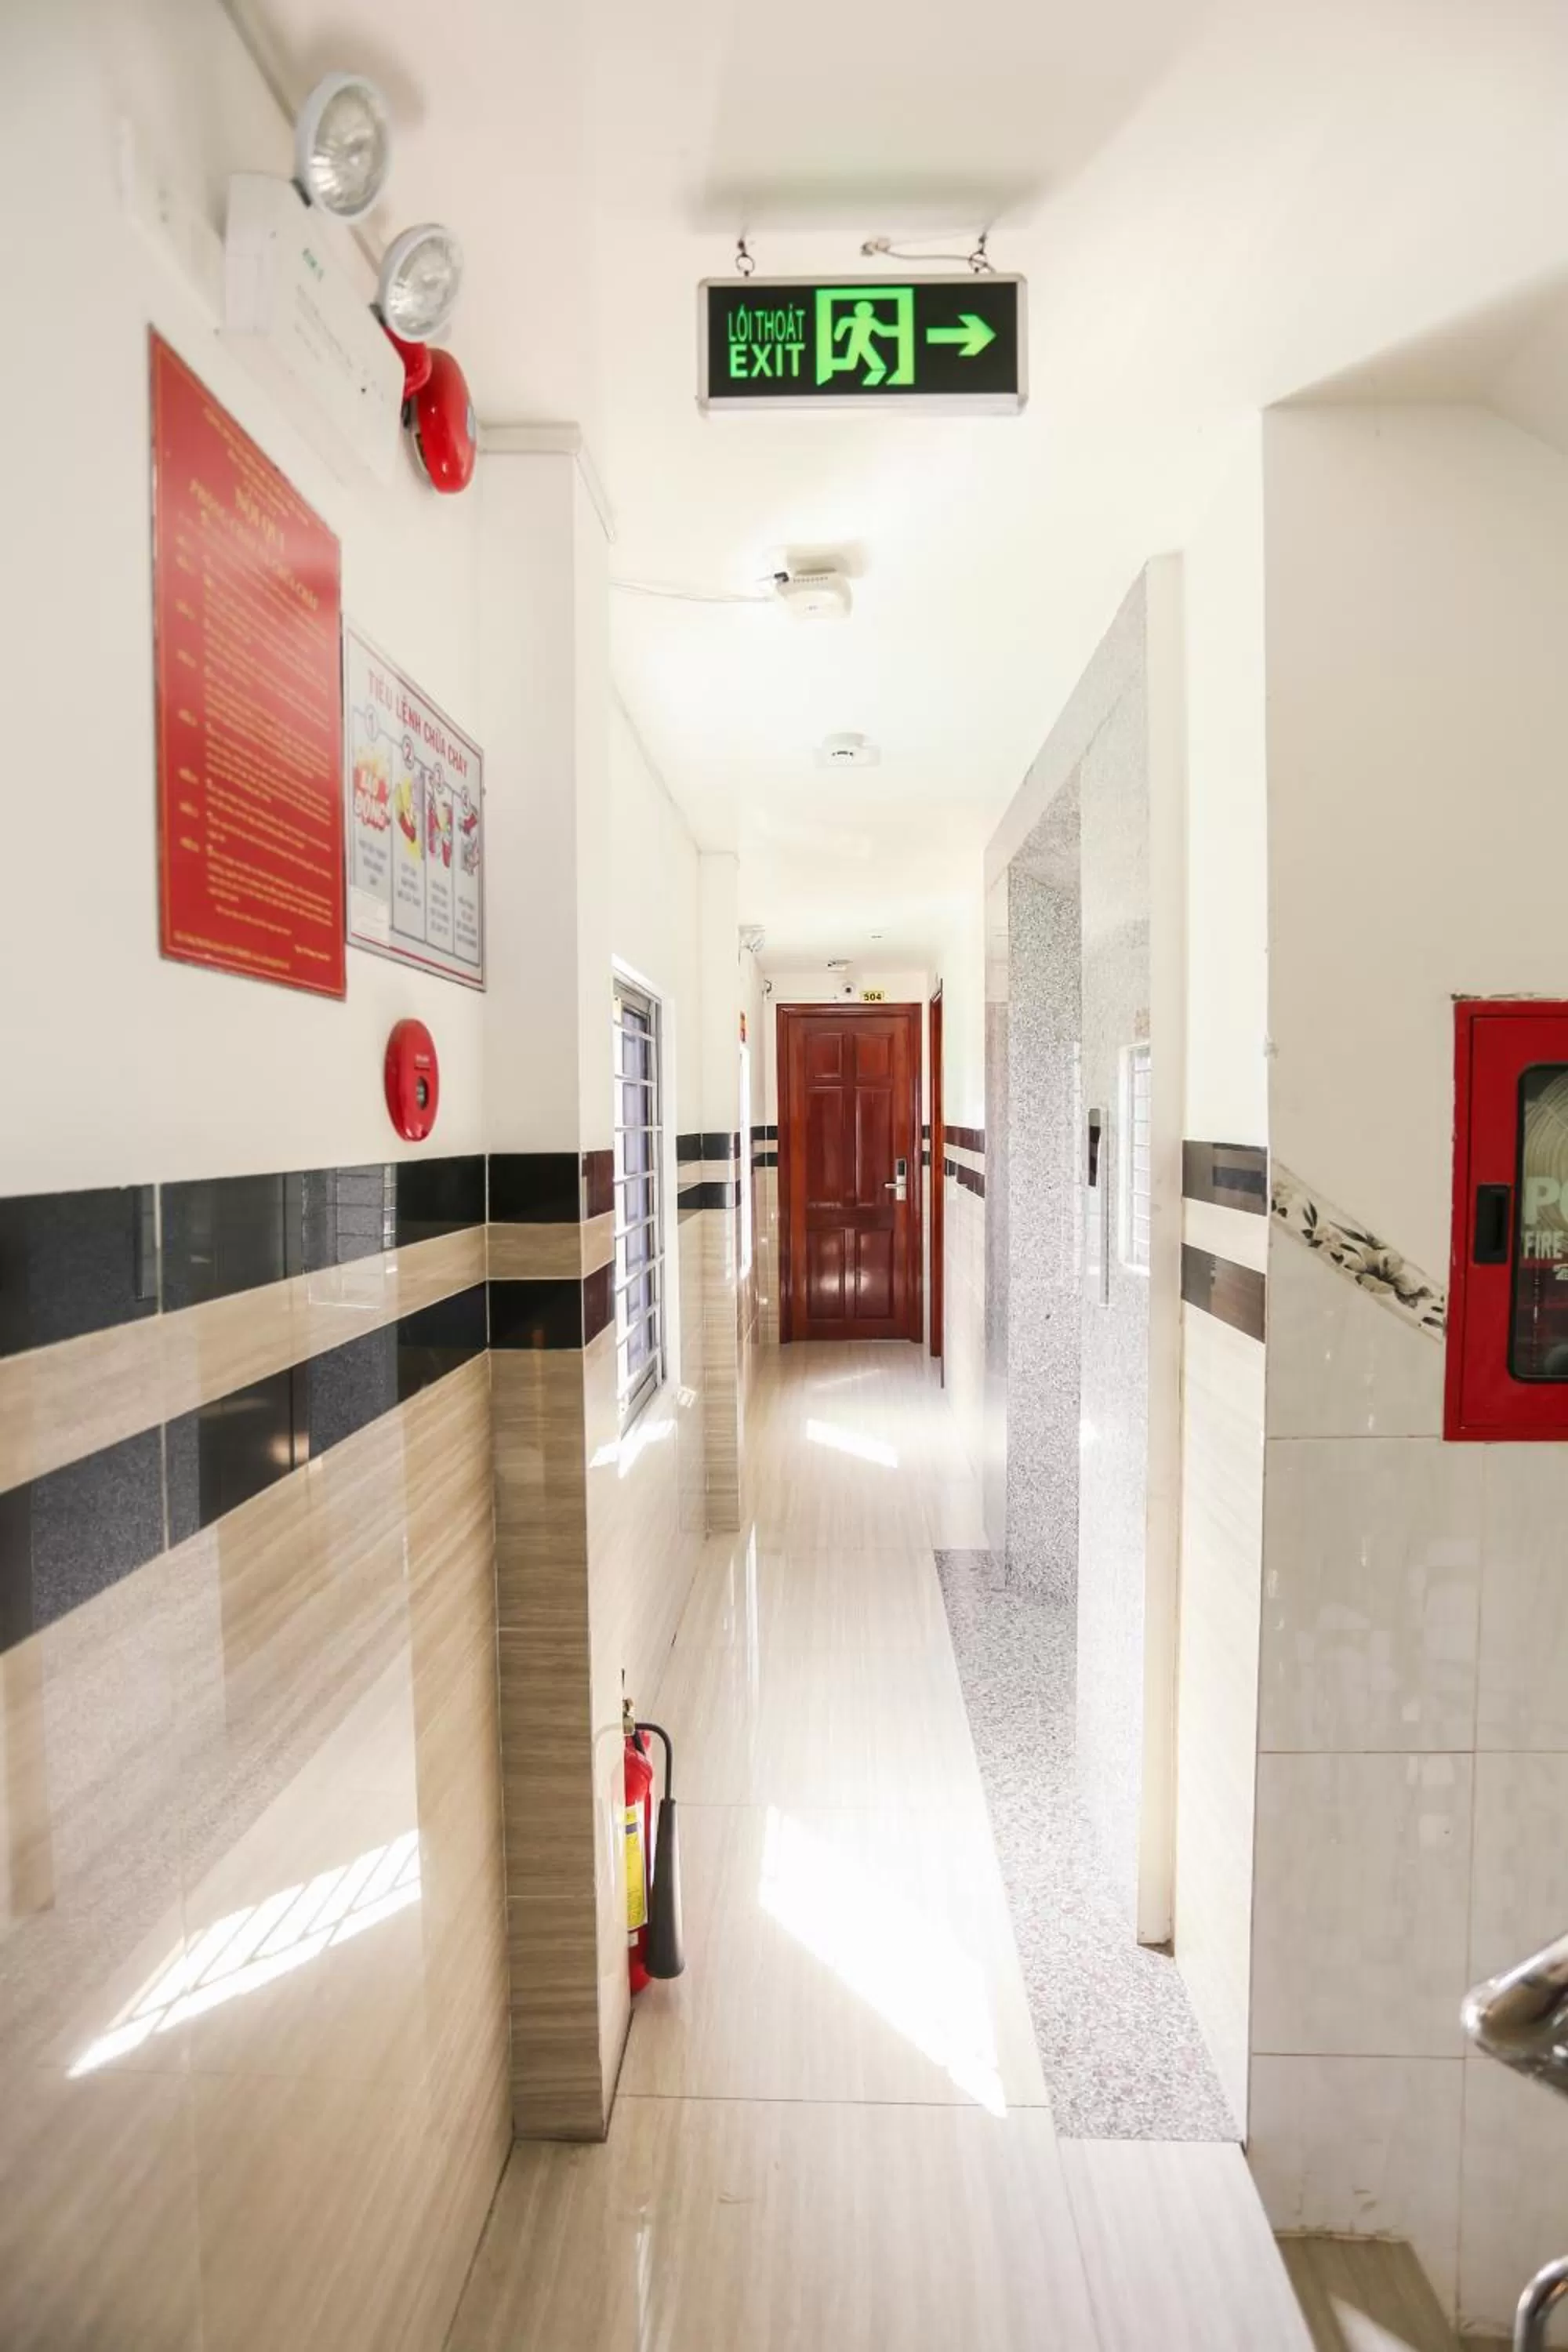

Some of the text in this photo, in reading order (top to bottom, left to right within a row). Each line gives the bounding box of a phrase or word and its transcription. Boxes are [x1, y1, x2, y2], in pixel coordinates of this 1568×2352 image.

[755, 303, 805, 342] THOÁT
[730, 343, 805, 378] EXIT
[1524, 1177, 1568, 1225] P
[1524, 1230, 1565, 1261] FIRE
